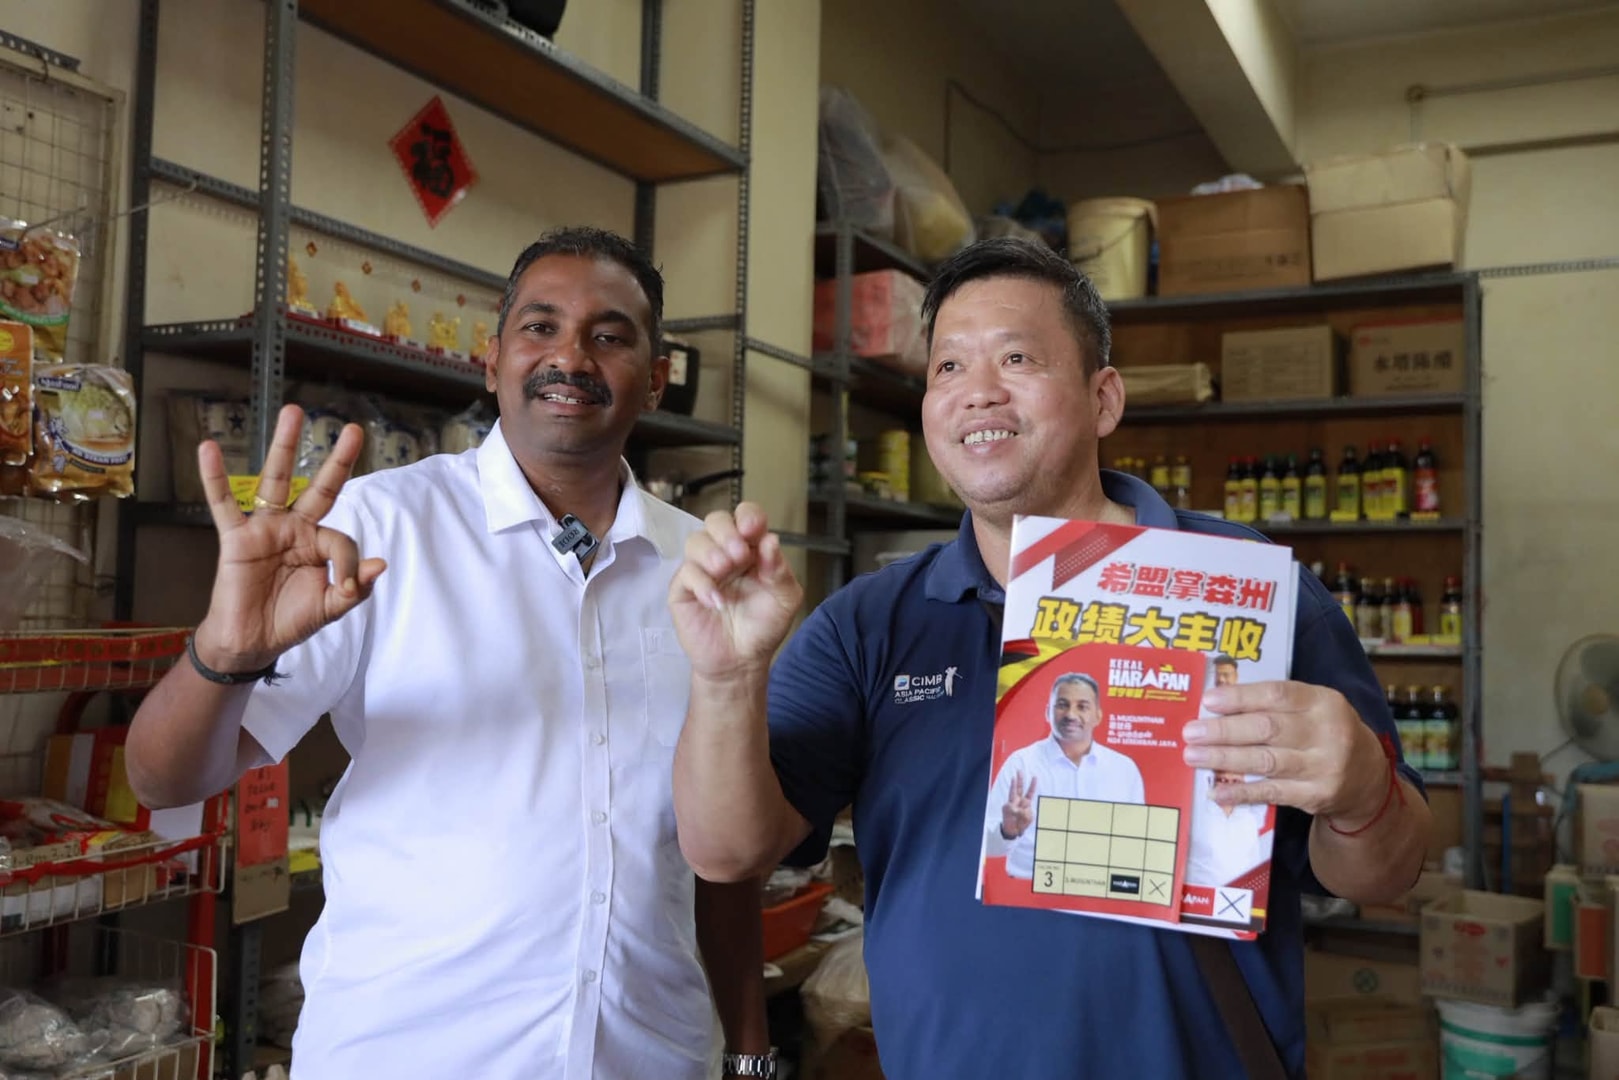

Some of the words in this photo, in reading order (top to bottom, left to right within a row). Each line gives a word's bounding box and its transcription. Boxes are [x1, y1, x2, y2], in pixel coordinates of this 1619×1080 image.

[1030, 597, 1266, 662] 政绩大丰收
[1109, 658, 1144, 671] KEKAL
[911, 673, 943, 687] CIMB
[1108, 668, 1190, 692] HARAPAN
[895, 690, 913, 698] ASIA
[1044, 871, 1053, 887] 3
[1182, 892, 1210, 905] APAN
